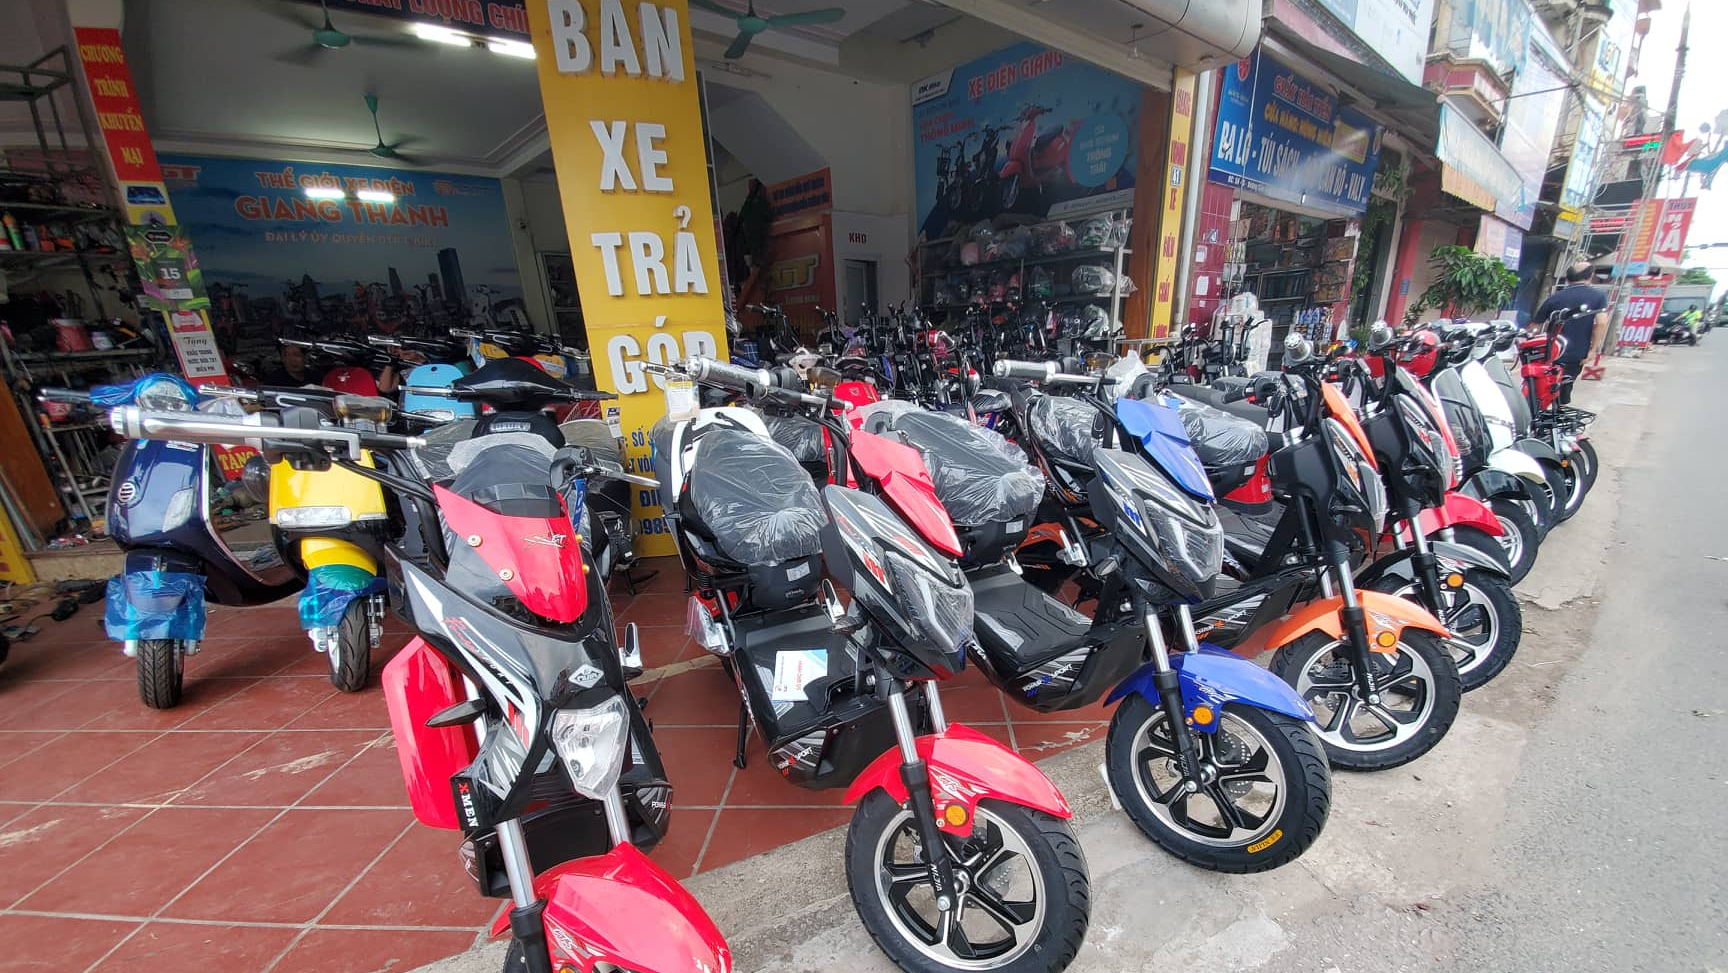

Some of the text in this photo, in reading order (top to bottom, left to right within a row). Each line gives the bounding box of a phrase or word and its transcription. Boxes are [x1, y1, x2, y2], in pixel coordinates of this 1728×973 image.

[588, 120, 674, 193] XE
[1217, 121, 1236, 163] BA
[235, 196, 341, 222] GIANG
[591, 205, 709, 296] TRẢ
[160, 267, 181, 280] 15
